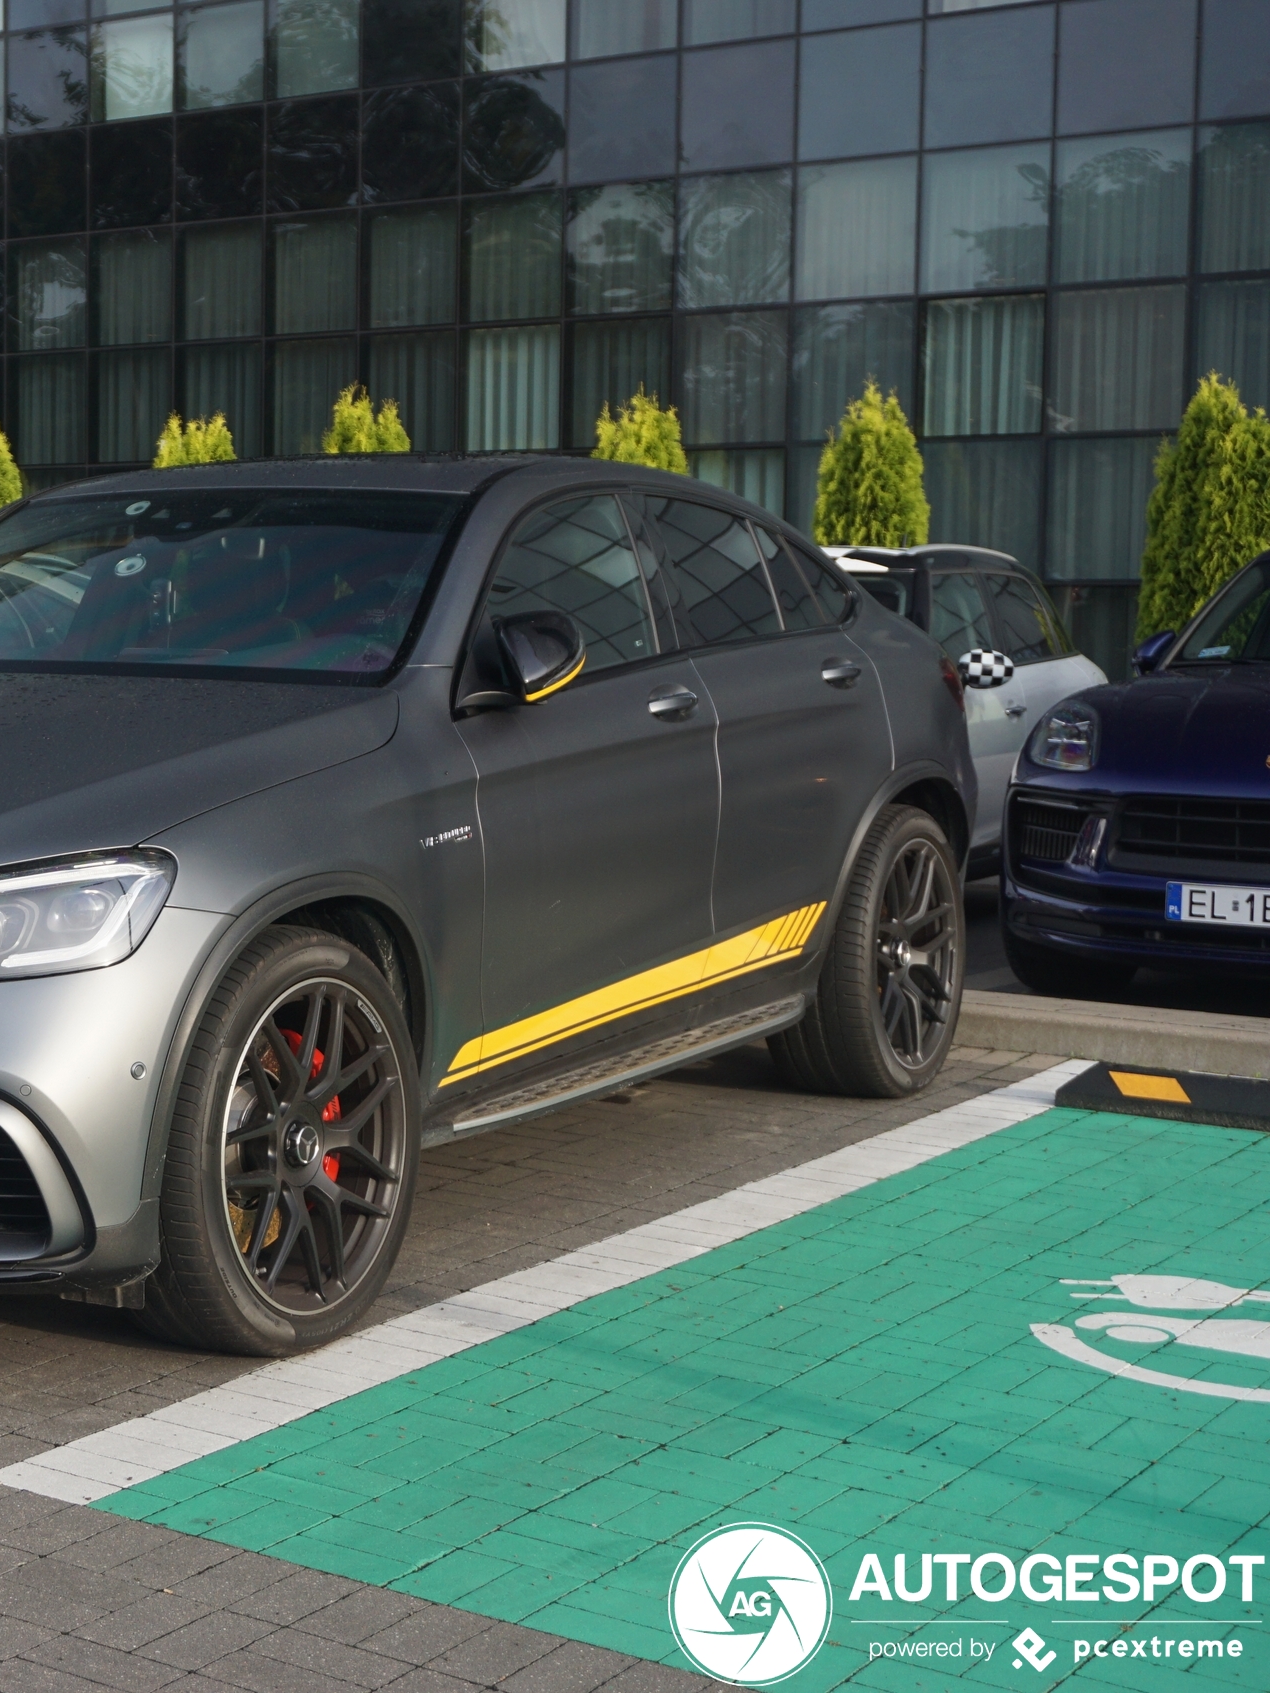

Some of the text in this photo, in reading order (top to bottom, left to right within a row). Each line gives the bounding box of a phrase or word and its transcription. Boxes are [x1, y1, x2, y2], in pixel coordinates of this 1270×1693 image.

[1169, 905, 1179, 914] PL
[1189, 889, 1227, 920] EL
[219, 1266, 239, 1300] OUTSIDE
